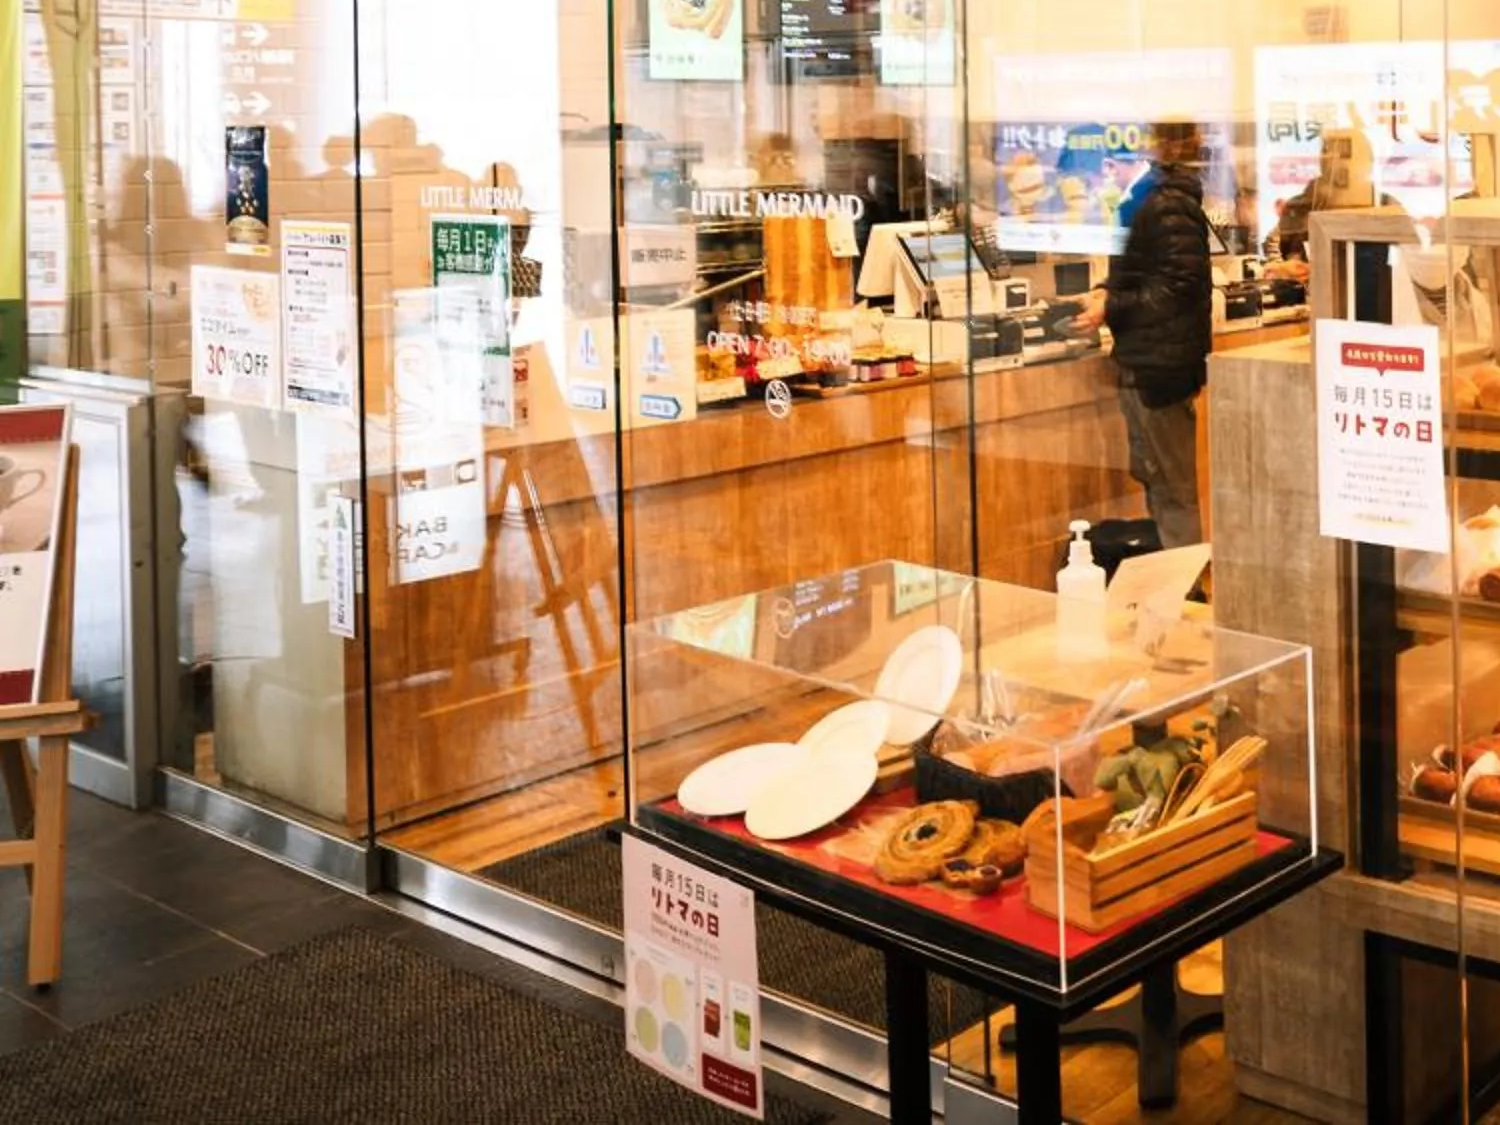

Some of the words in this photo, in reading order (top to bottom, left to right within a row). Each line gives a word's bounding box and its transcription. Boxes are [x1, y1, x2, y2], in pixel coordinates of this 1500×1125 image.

[420, 187, 467, 208] LITTLE
[691, 191, 752, 216] LITTLE
[756, 192, 864, 221] MERMAID
[1333, 385, 1433, 412] 毎月15日は
[1334, 413, 1433, 444] リトマの日
[651, 862, 720, 909] 毎月15日は
[650, 887, 720, 938] リトマの日
